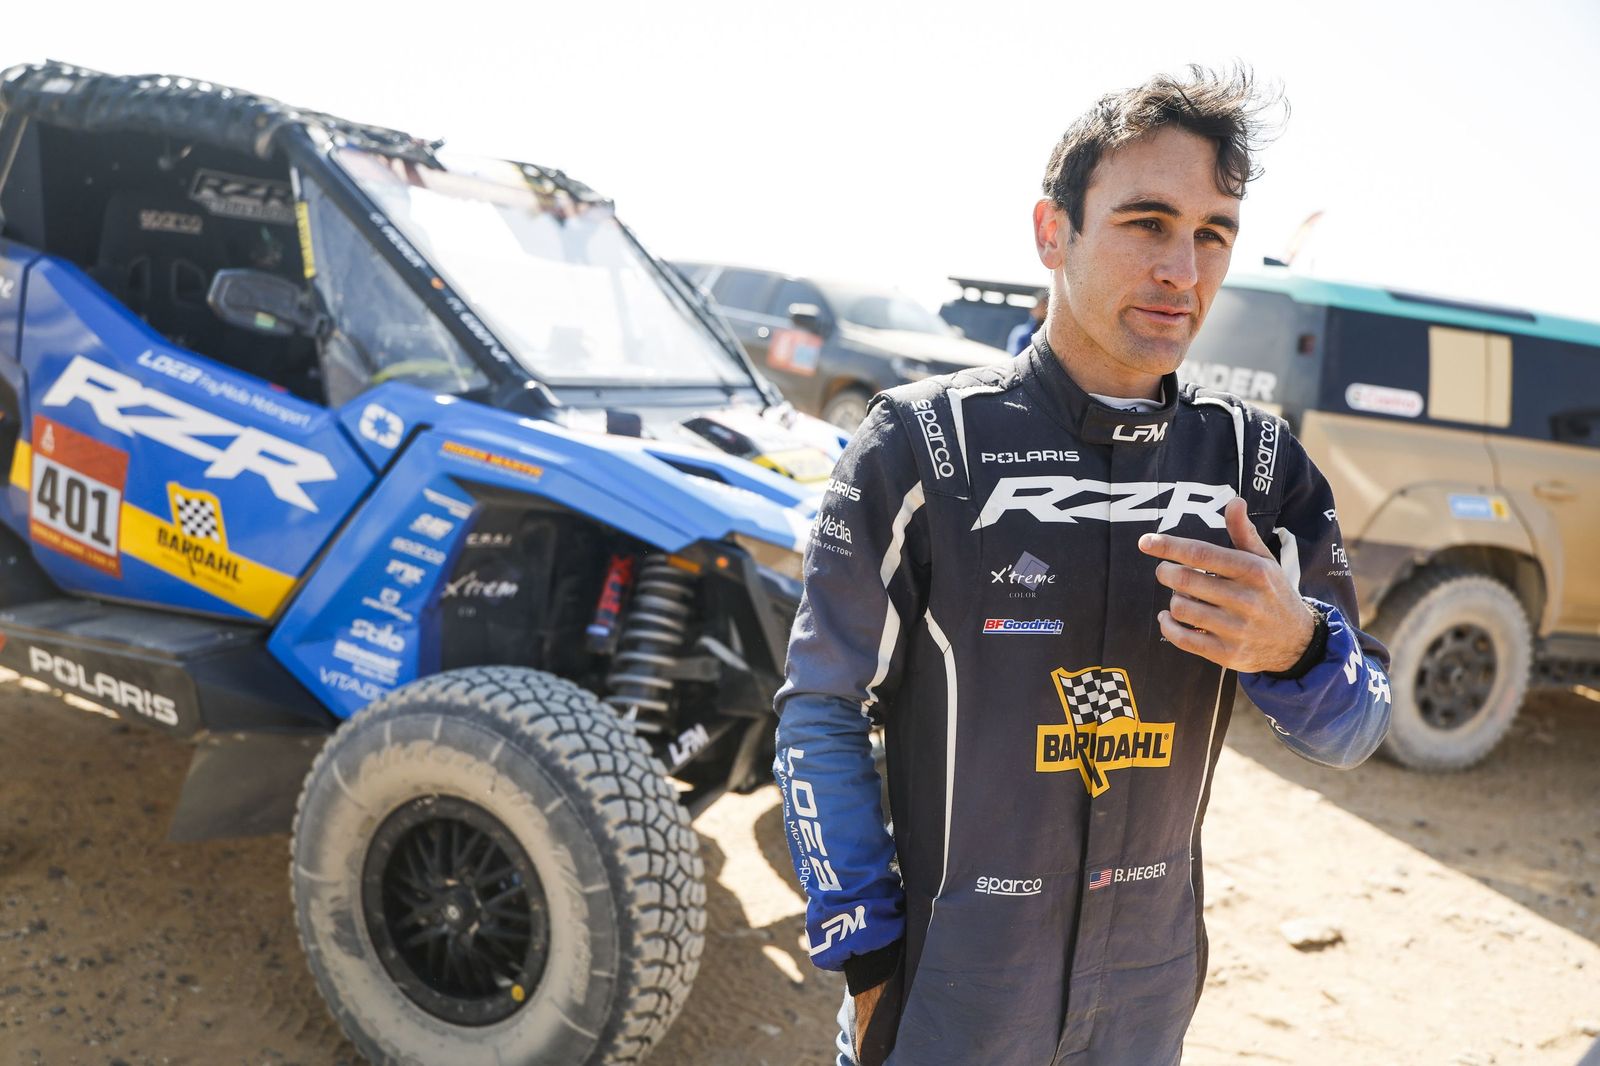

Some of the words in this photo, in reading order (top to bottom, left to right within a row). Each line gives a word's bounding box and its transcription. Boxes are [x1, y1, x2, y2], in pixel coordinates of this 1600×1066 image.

[42, 355, 338, 513] RZR
[911, 399, 954, 480] sparco
[981, 450, 1080, 464] POLARIS
[1112, 421, 1168, 442] LFM
[1253, 420, 1280, 495] sparco
[37, 464, 112, 546] 401
[970, 475, 1240, 534] RZR
[157, 527, 242, 584] BARDAHL
[823, 542, 853, 557] FACTORY
[984, 619, 1064, 631] BFGoodrich
[29, 645, 179, 726] POLARIS
[1043, 732, 1167, 763] BARDAHL
[975, 876, 1042, 896] sparco
[1114, 862, 1166, 882] B.HEGER
[805, 904, 867, 957] LFM
